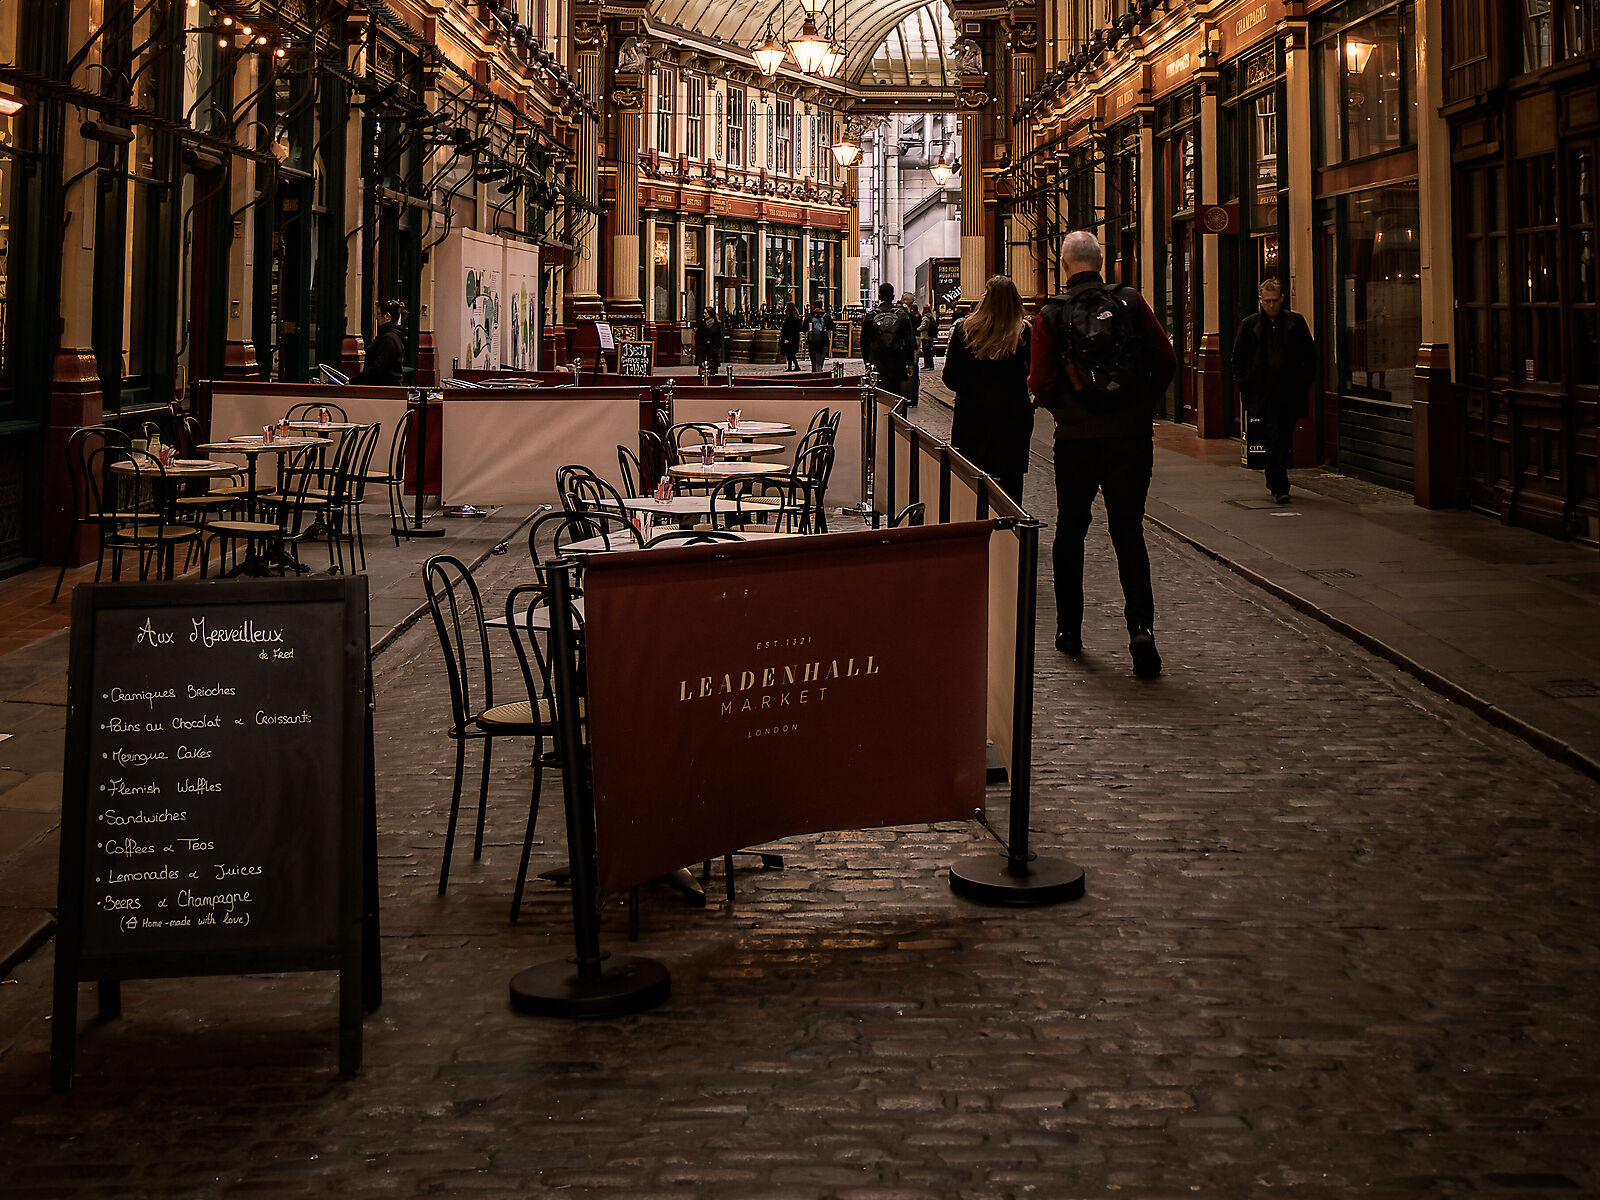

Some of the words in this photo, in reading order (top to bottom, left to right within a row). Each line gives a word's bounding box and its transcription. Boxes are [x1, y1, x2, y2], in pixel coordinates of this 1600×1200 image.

[1236, 3, 1267, 37] CHAMPAGNE
[622, 343, 650, 357] BEST
[137, 616, 175, 648] Aux
[189, 616, 284, 648] Merveilleux
[259, 649, 268, 660] de
[272, 648, 295, 662] Fred
[679, 655, 880, 701] LEADENHALL
[111, 686, 176, 710] Cramiques
[188, 683, 236, 699] Brioches
[720, 686, 828, 716] MARKET
[107, 717, 140, 732] Pains
[146, 722, 164, 732] au
[172, 714, 222, 730] Chocolat
[255, 710, 313, 725] Croissants
[748, 723, 799, 739] LONDON
[112, 748, 168, 768] Meringue
[176, 745, 213, 760] Cakes
[108, 778, 160, 796] Flemish
[177, 777, 222, 796] Waffles
[105, 808, 188, 826] Sandwiches
[106, 838, 154, 858] Coffees
[109, 864, 180, 884] Lemonades
[213, 864, 263, 881] Juices
[103, 895, 142, 910] Beers
[177, 890, 253, 912] Champagne
[198, 912, 216, 925] with
